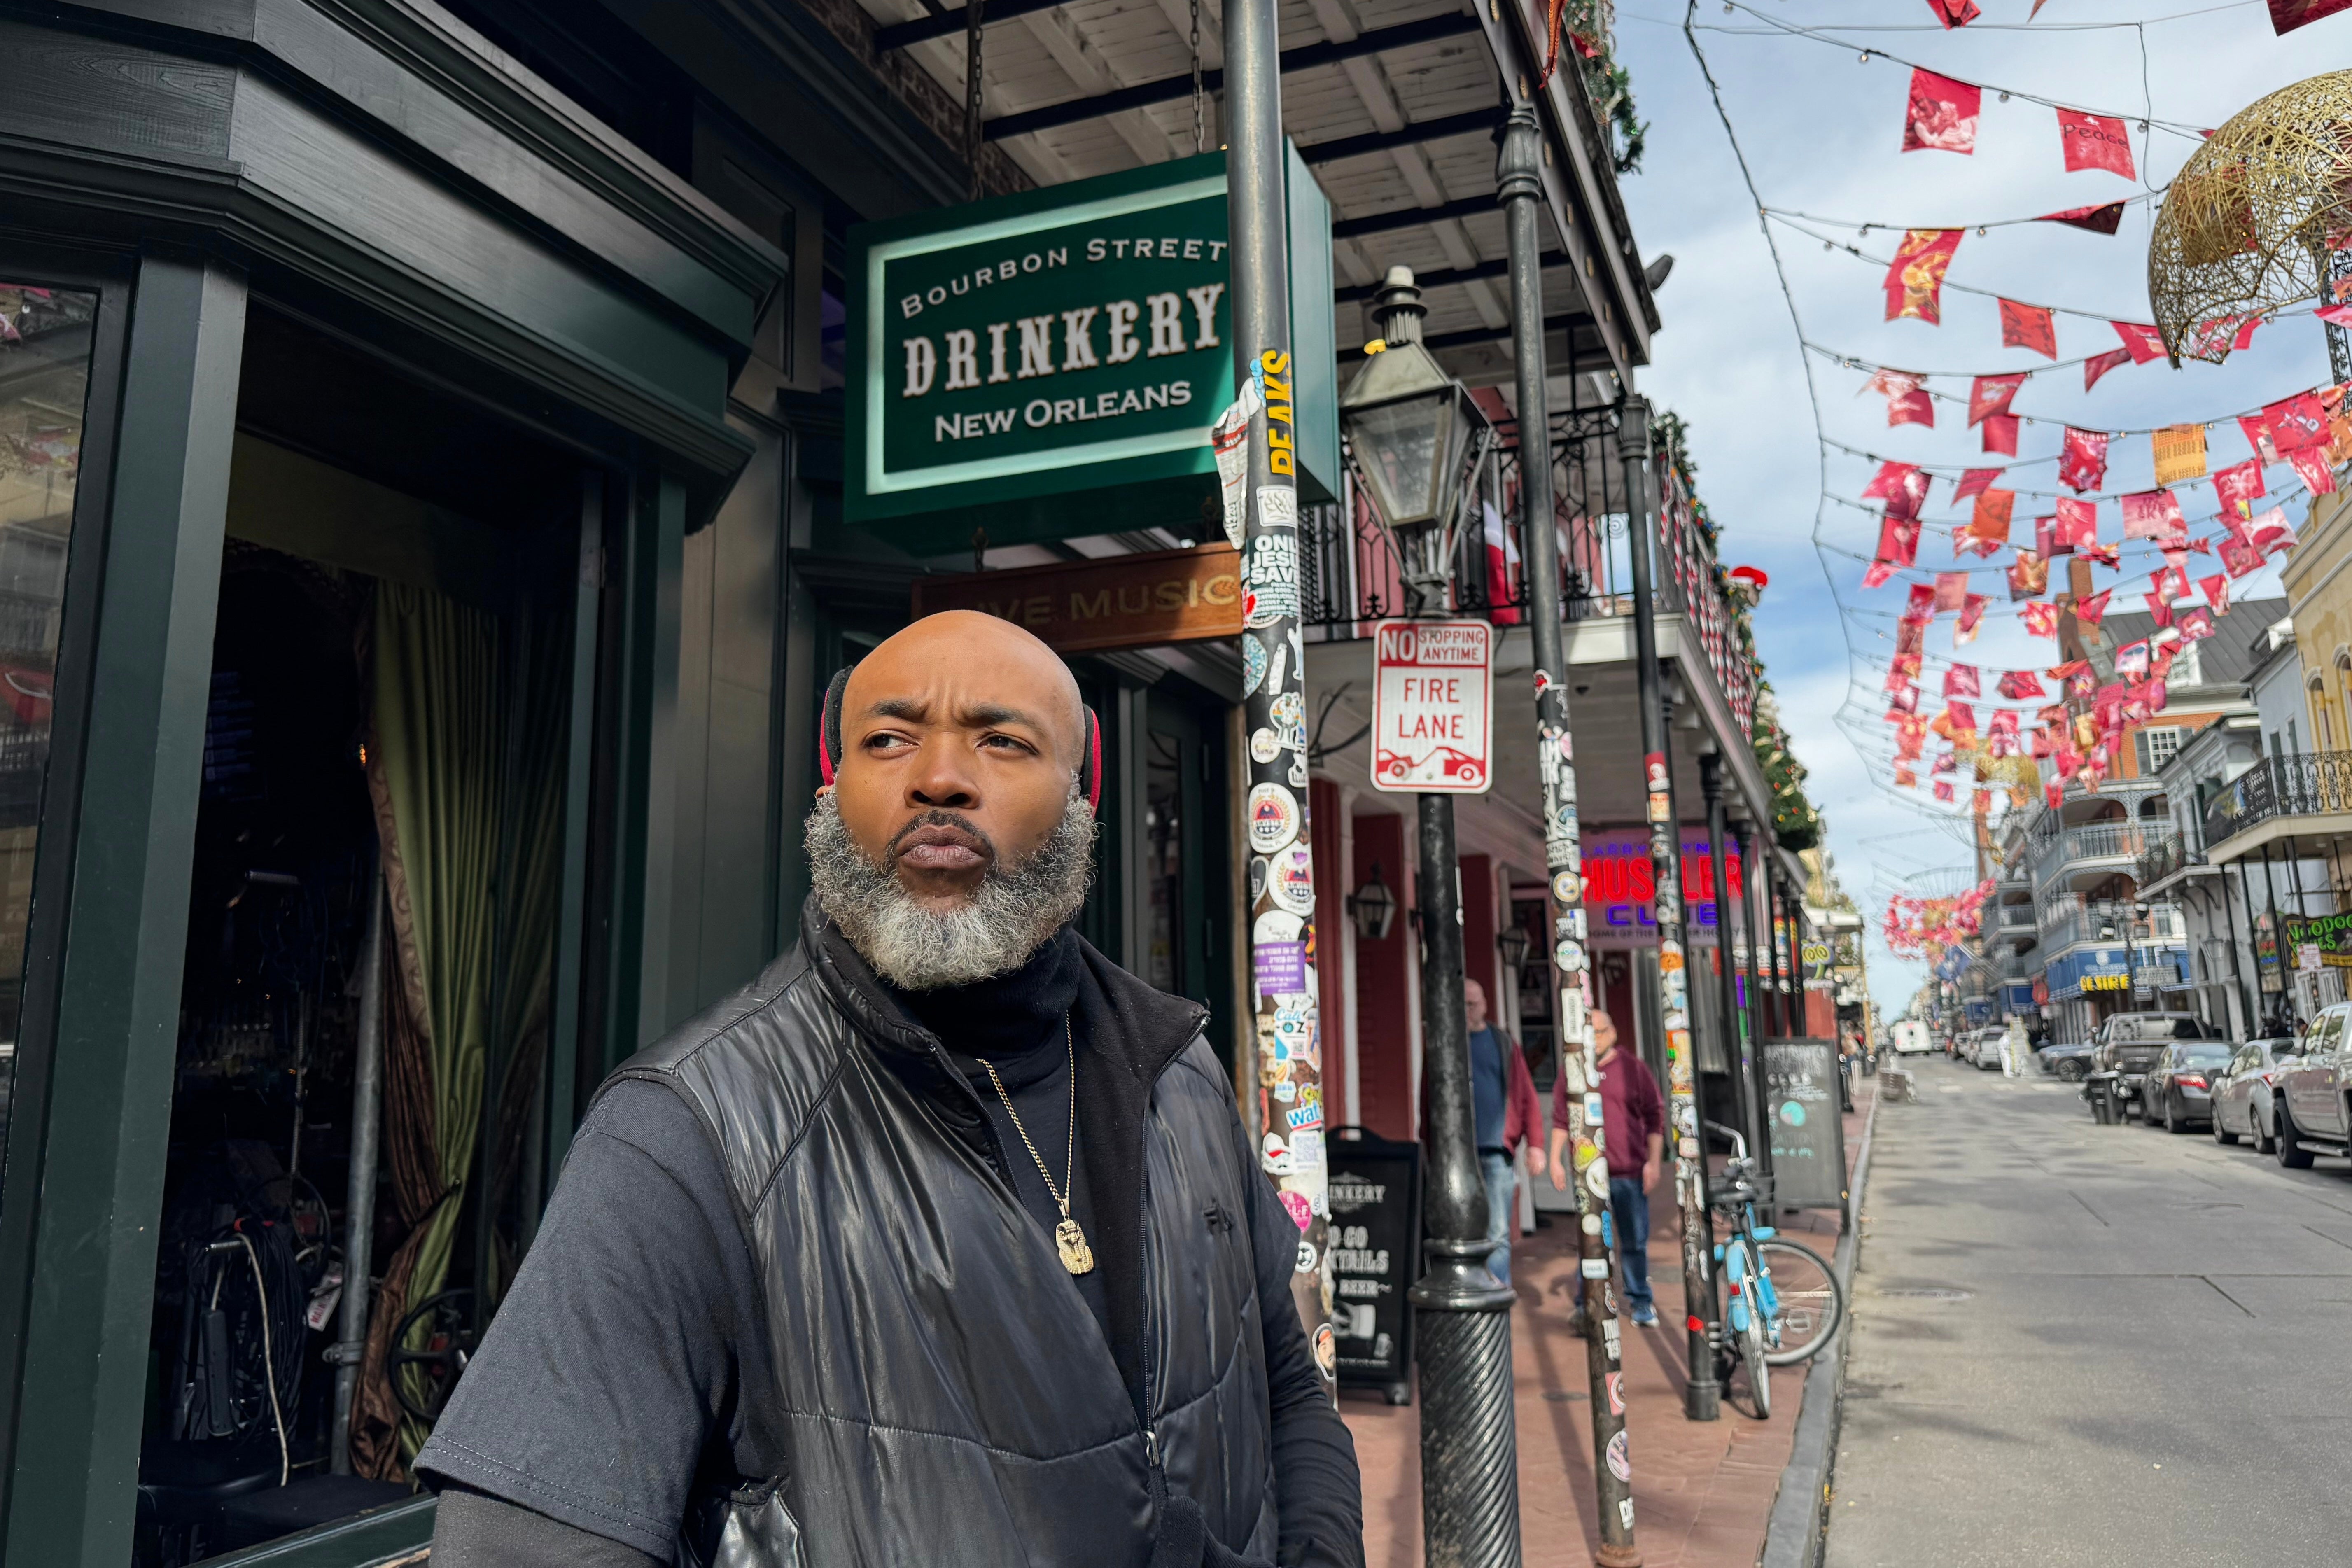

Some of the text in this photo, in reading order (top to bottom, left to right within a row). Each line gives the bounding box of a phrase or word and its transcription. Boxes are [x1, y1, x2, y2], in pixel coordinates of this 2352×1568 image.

[2063, 123, 2129, 149] Peace
[901, 237, 1227, 320] BOURBON STREET
[902, 282, 1226, 399] DRINKERY
[935, 380, 1192, 443] NEW ORLEANS
[1255, 534, 1299, 553] ONL
[1251, 550, 1300, 570] JESU
[980, 574, 1238, 625] VE MUSIC
[1382, 628, 1484, 662] NO STOPPING
[1423, 647, 1479, 661] ANYTIME
[1404, 678, 1460, 703] FIRE
[1398, 714, 1464, 739] LANE
[1580, 854, 1744, 903] HUSLER
[2080, 973, 2130, 992] DESIRE
[1329, 1184, 1387, 1204] INKERY
[1329, 1225, 1369, 1250] O-GO
